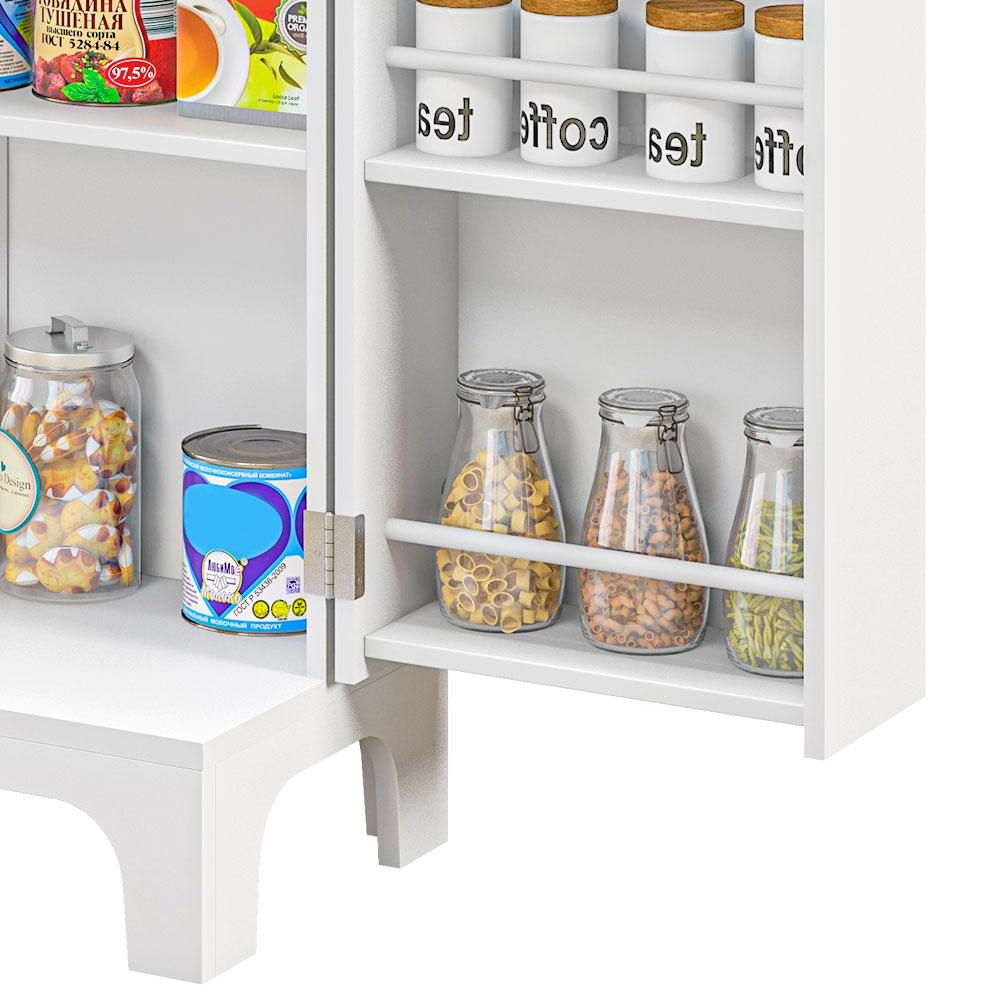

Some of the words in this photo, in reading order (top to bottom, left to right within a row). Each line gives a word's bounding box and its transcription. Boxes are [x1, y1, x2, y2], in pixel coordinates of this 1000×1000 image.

[40, 6, 123, 30] ТУШЕНАЯ
[42, 33, 64, 47] ГОСТ
[69, 39, 120, 51] 5284-84
[112, 67, 154, 82] 97,5%
[4, 473, 31, 491] Design
[250, 622, 282, 630] ПРОДУКТ
